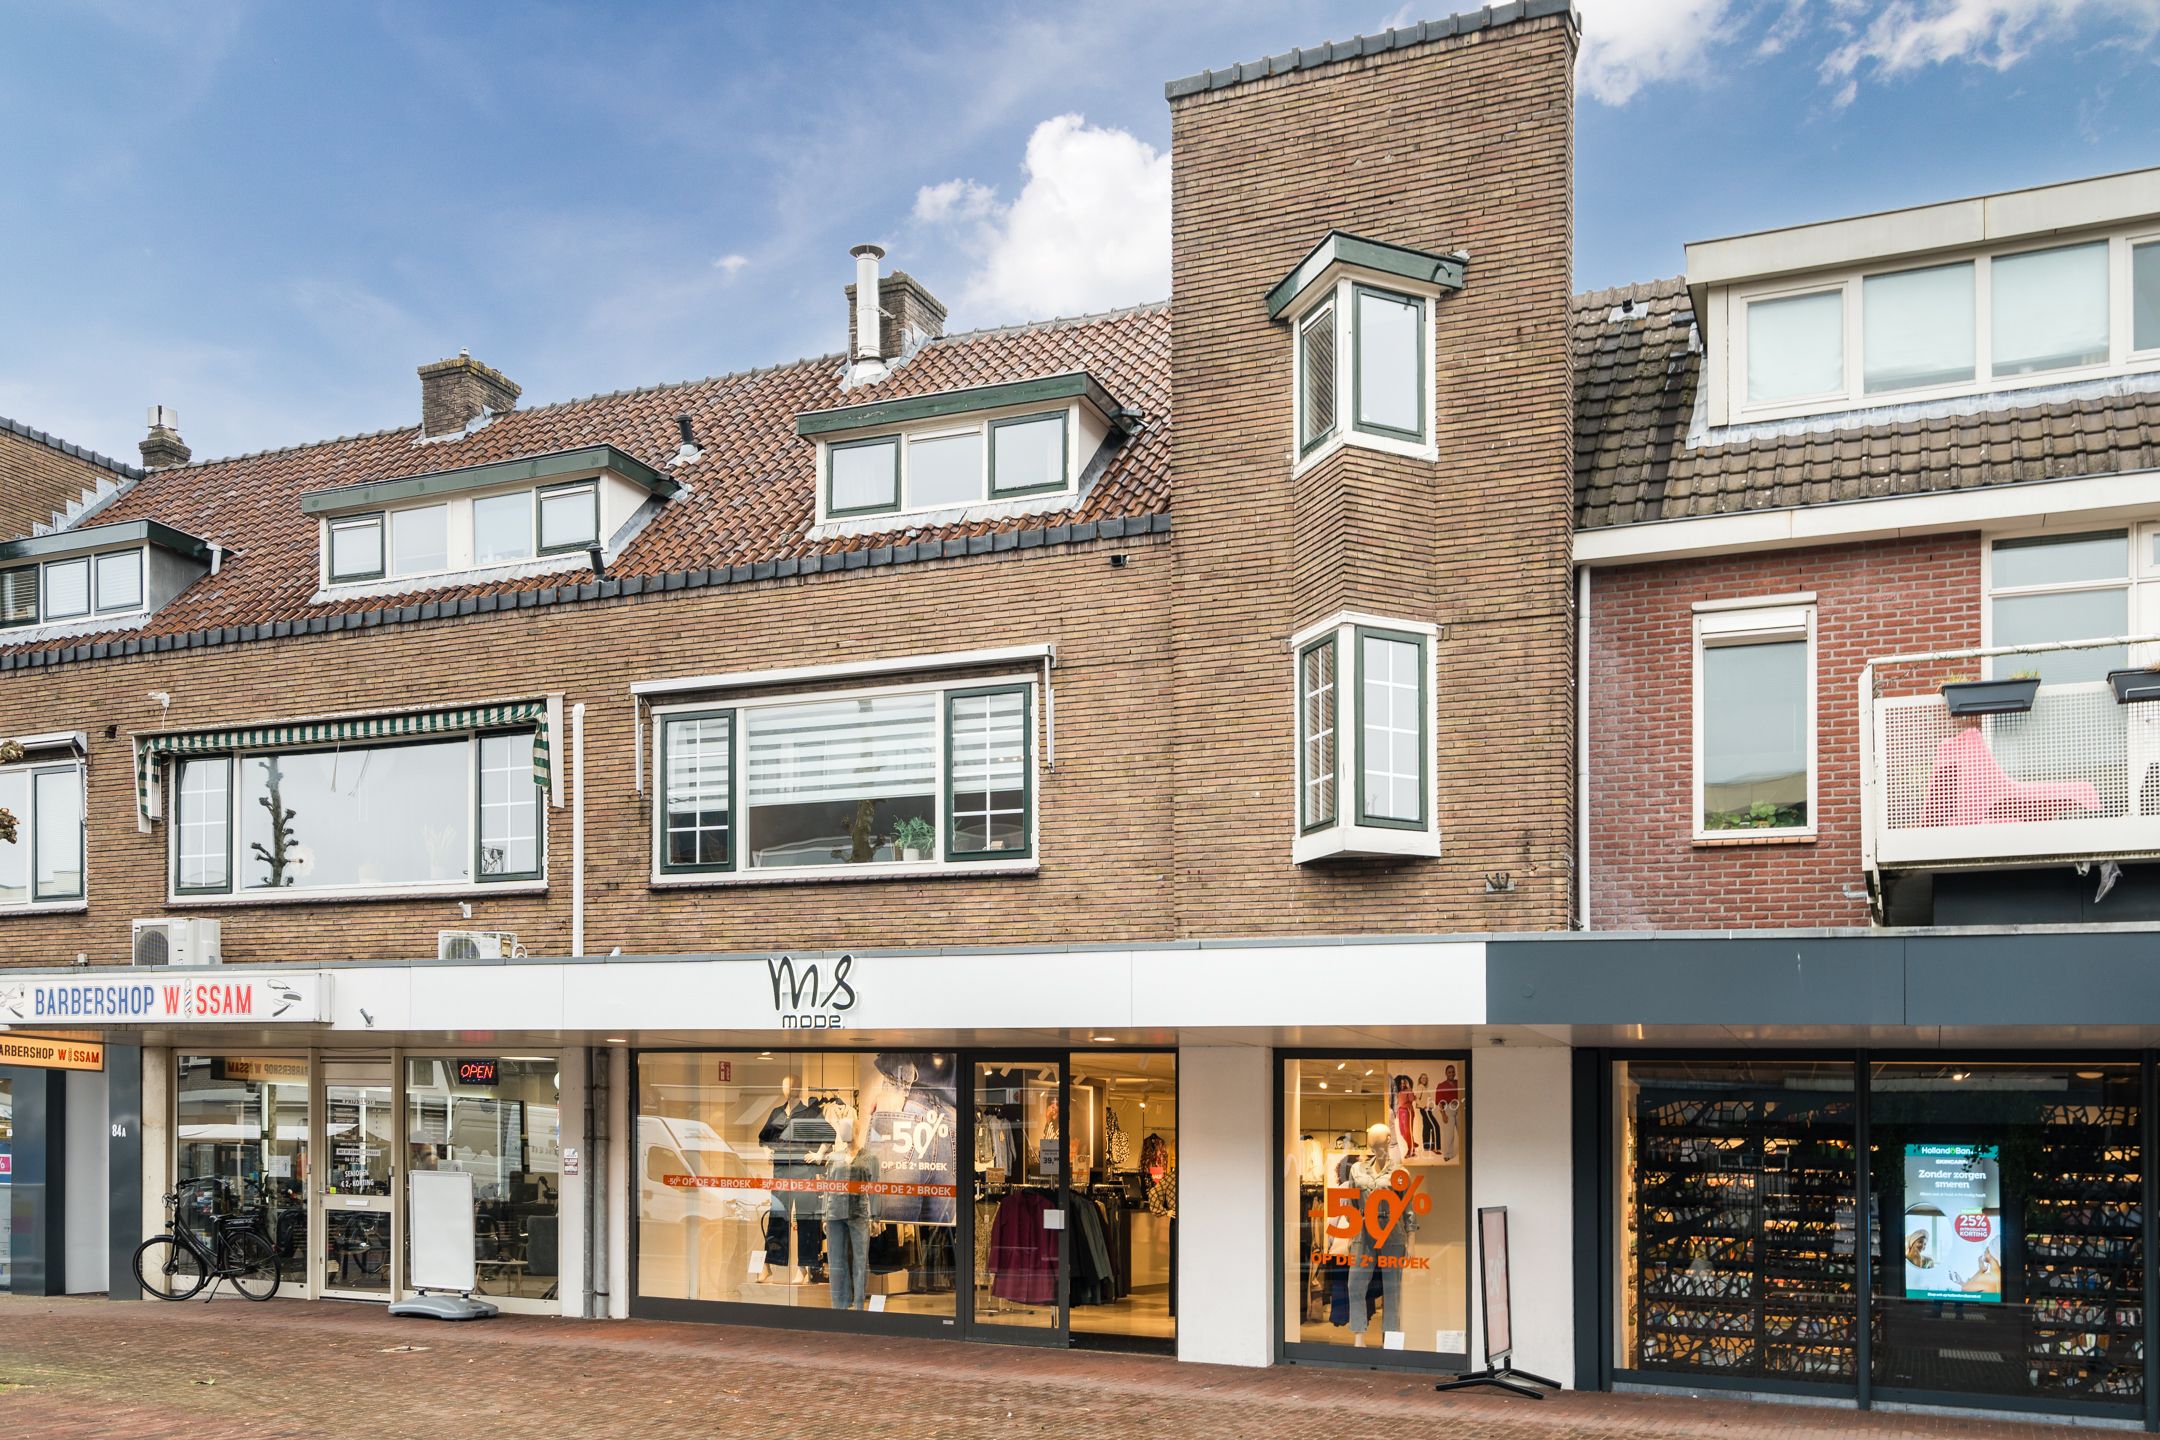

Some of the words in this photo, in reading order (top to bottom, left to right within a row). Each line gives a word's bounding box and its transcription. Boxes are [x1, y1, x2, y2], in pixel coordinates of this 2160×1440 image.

[35, 985, 155, 1017] BARBERSHOP
[0, 1043, 54, 1060] ARBERSHOP
[460, 1064, 494, 1079] OPEN
[111, 1123, 127, 1137] 84A
[881, 1160, 894, 1169] OP
[895, 1161, 907, 1170] DE
[918, 1162, 948, 1171] BROEK
[1918, 1170, 1952, 1179] Zonder
[1953, 1171, 1987, 1181] zorgen
[682, 1177, 695, 1186] OP
[696, 1178, 708, 1187] DE
[720, 1179, 751, 1188] BROEK
[776, 1180, 789, 1190] OP
[790, 1181, 803, 1190] DE
[816, 1182, 848, 1191] BROEK
[875, 1184, 888, 1193] OP
[891, 1185, 903, 1194] DE
[917, 1186, 951, 1196] BROEK
[1935, 1181, 1970, 1189] smeren
[1308, 1169, 1433, 1249] -50%
[1960, 1214, 1987, 1227] 25%
[1311, 1253, 1333, 1265] OP
[1336, 1254, 1356, 1266] DE
[1377, 1255, 1430, 1269] BROEK
